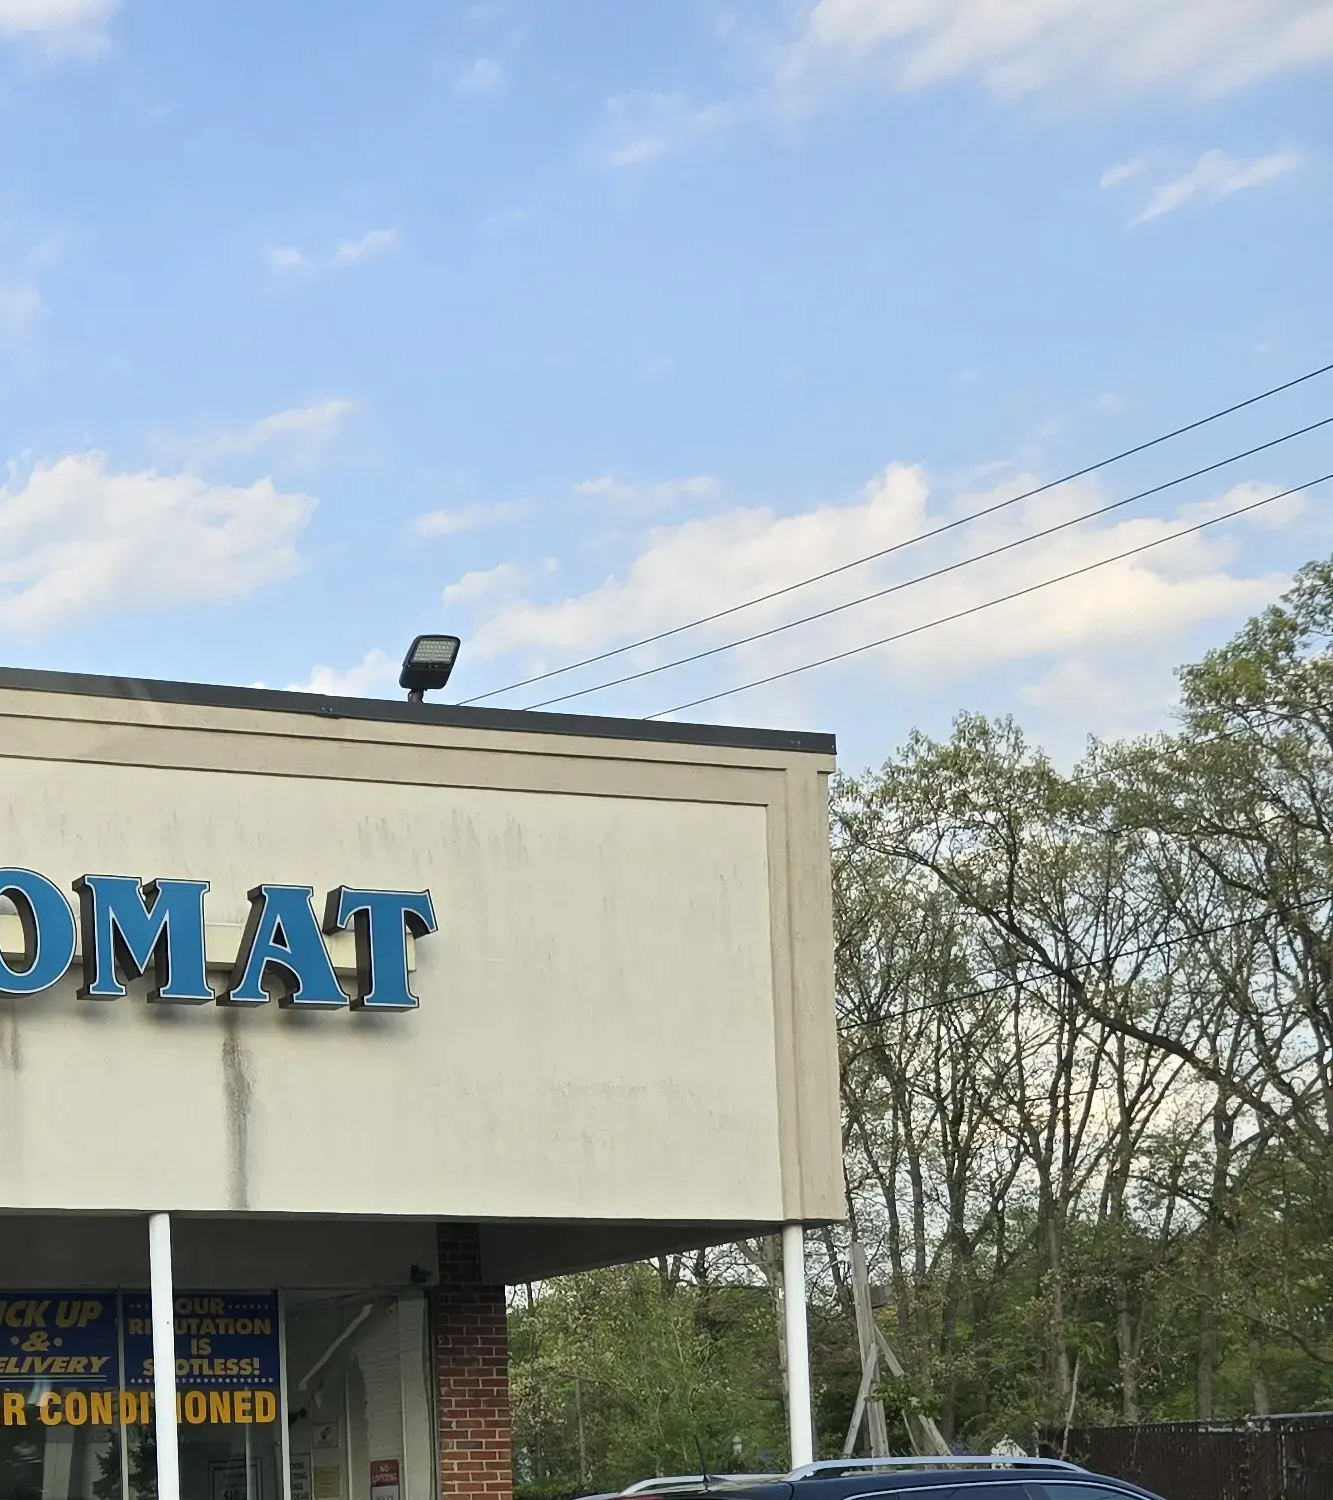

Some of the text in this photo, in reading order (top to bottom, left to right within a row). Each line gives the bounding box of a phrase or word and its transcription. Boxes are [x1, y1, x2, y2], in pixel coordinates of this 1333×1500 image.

[55, 1301, 104, 1328] UP
[174, 1297, 226, 1316] OUR
[190, 1338, 212, 1355] IS
[142, 1357, 261, 1376] SOTLESS!
[39, 1390, 277, 1427] CONDIIONED
